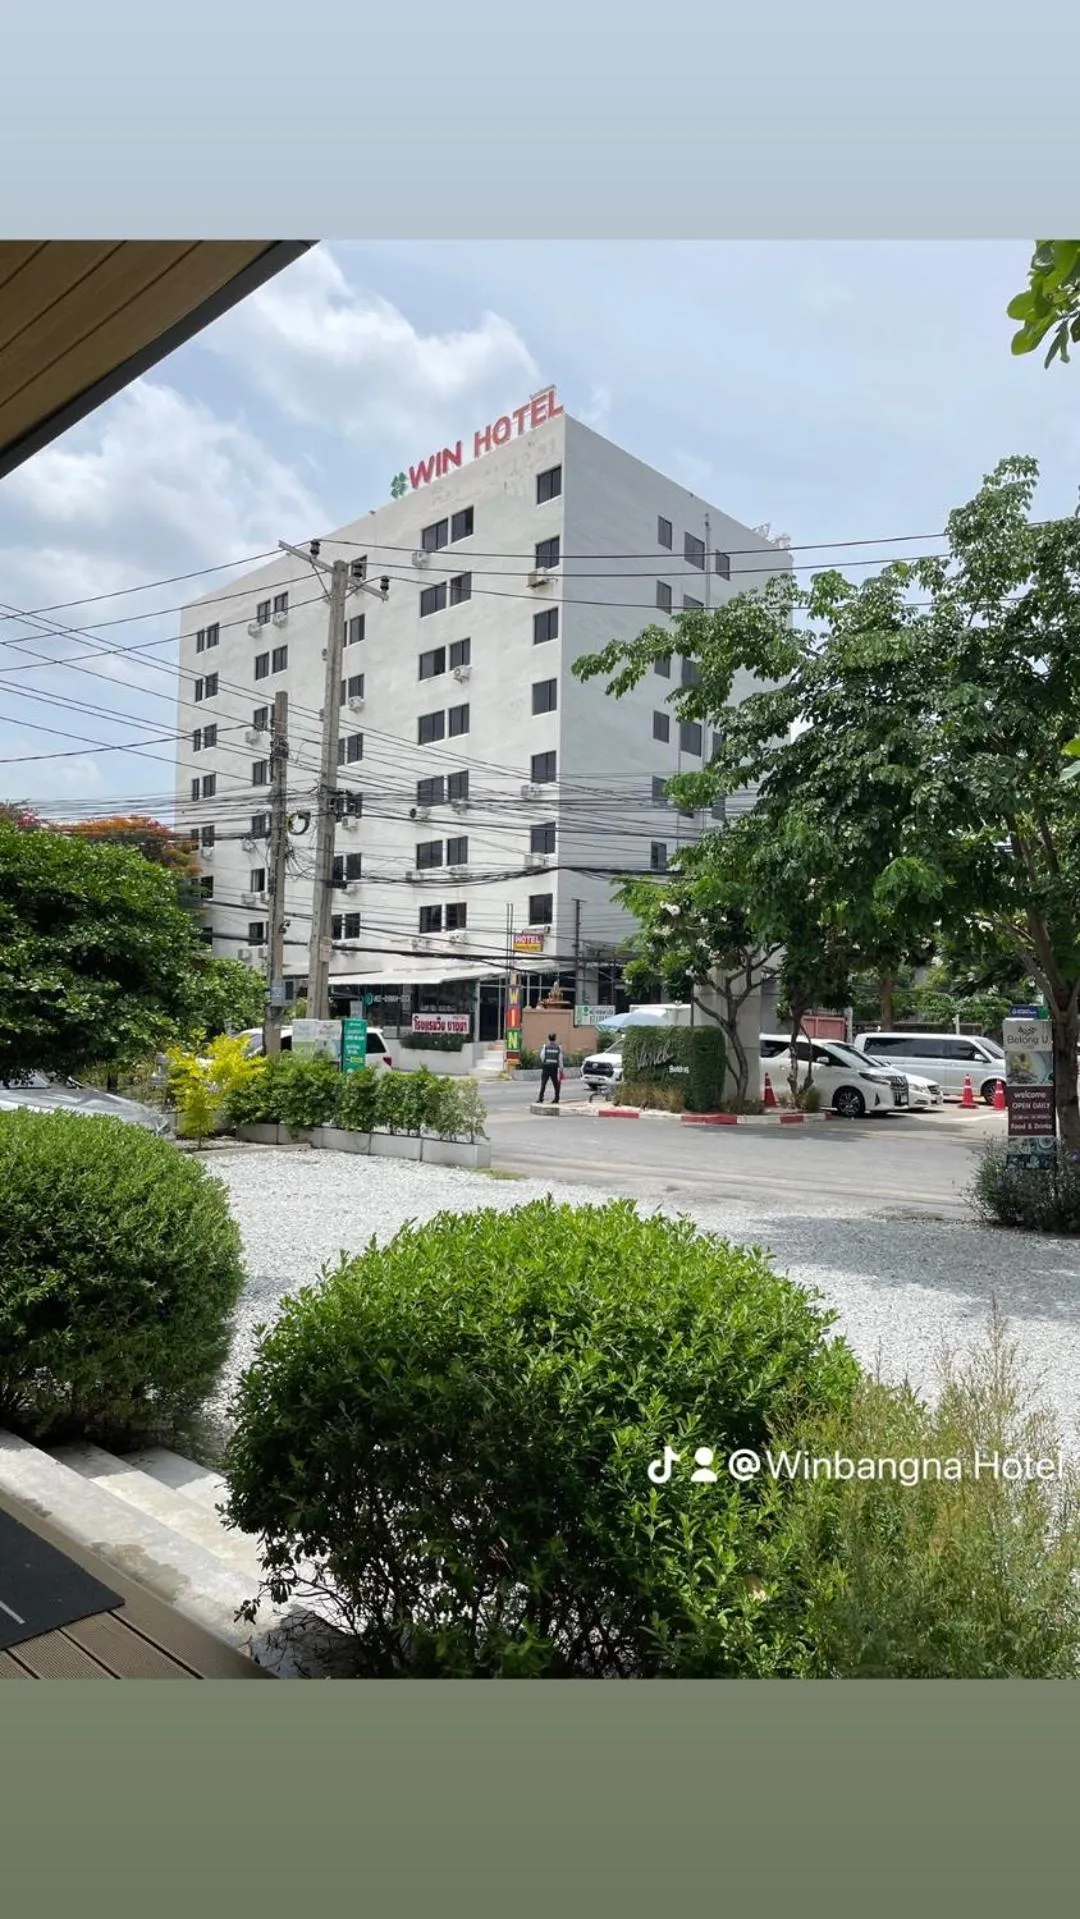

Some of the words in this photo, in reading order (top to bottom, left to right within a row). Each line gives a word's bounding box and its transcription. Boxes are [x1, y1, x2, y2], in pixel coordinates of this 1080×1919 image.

[408, 440, 462, 490] WIN
[474, 390, 564, 458] HOTEL
[514, 934, 542, 944] HOTEL
[1013, 1090, 1047, 1099] welcome
